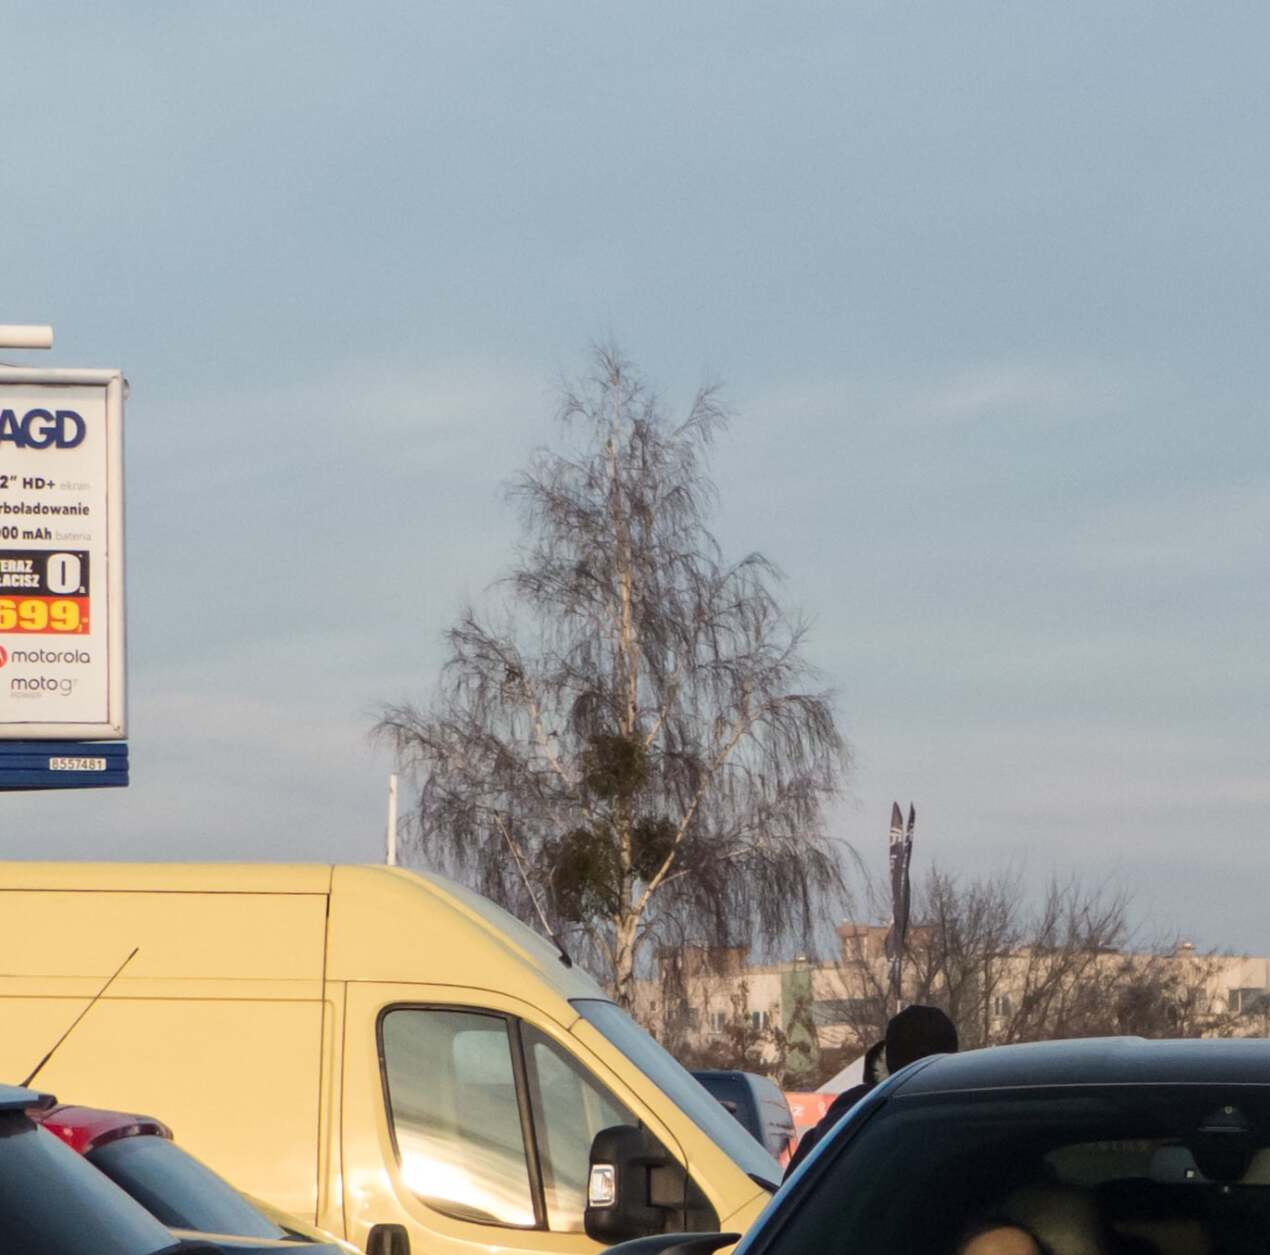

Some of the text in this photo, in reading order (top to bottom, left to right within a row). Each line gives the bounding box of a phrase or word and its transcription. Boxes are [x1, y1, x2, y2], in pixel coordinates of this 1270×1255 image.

[0, 408, 87, 450] AGD
[23, 477, 55, 489] HD+
[0, 526, 18, 539] 00
[22, 528, 52, 540] mAh
[0, 559, 33, 573] ERAZ
[11, 648, 91, 664] motorola
